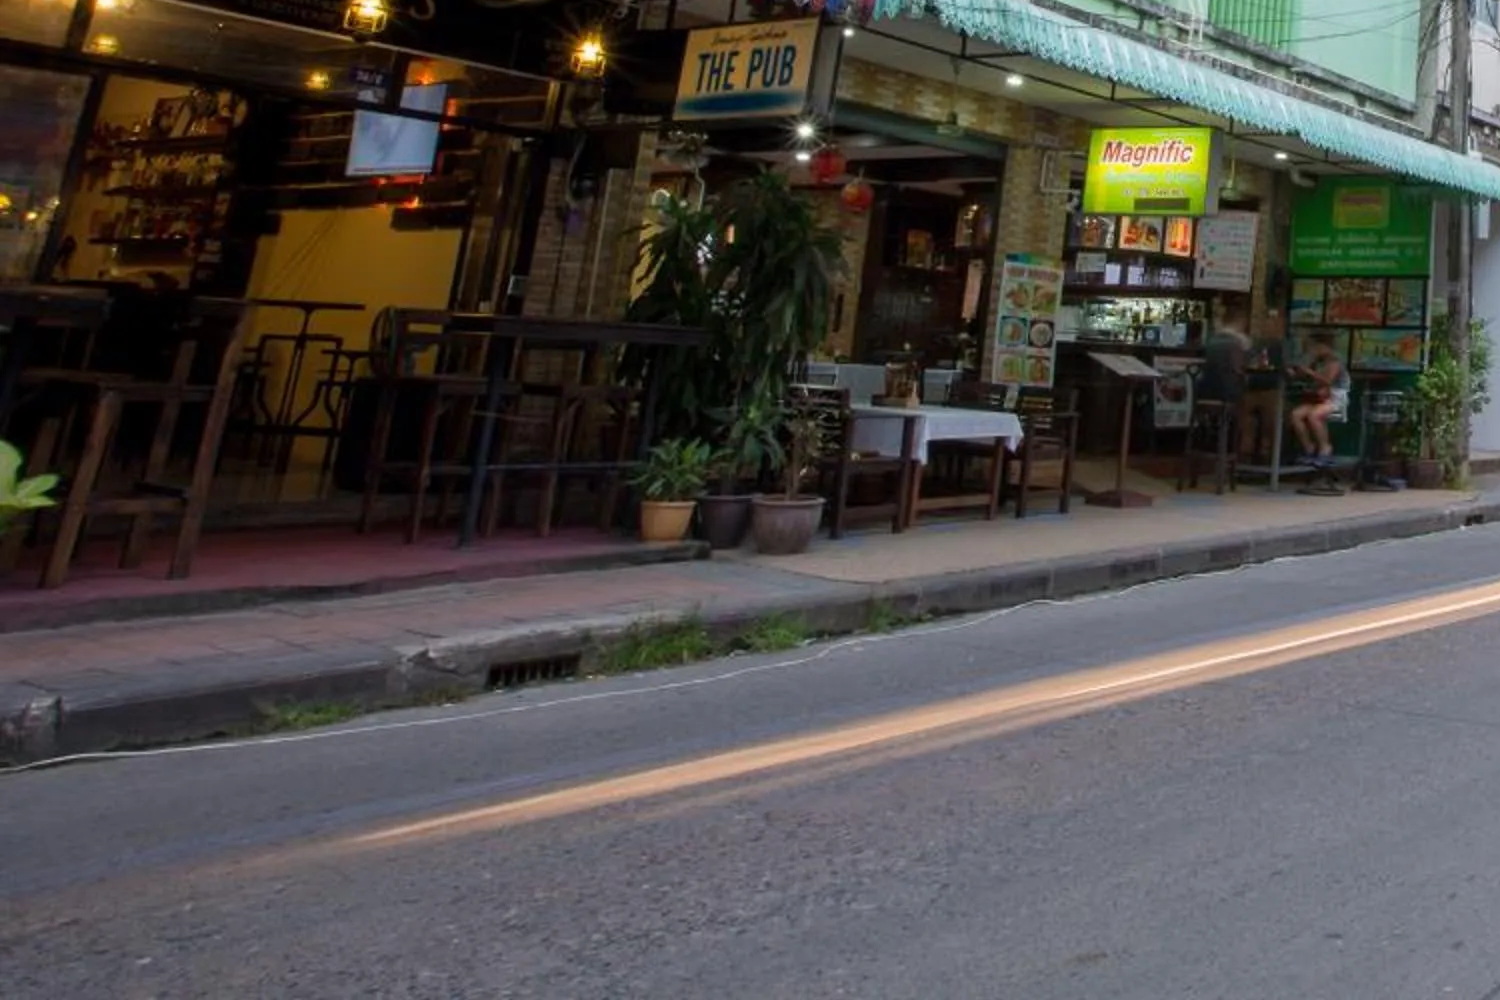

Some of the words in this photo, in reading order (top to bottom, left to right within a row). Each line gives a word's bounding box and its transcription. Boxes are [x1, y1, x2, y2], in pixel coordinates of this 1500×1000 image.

[697, 50, 741, 92] THE
[746, 45, 797, 89] PUB
[1103, 138, 1193, 166] Magnific
